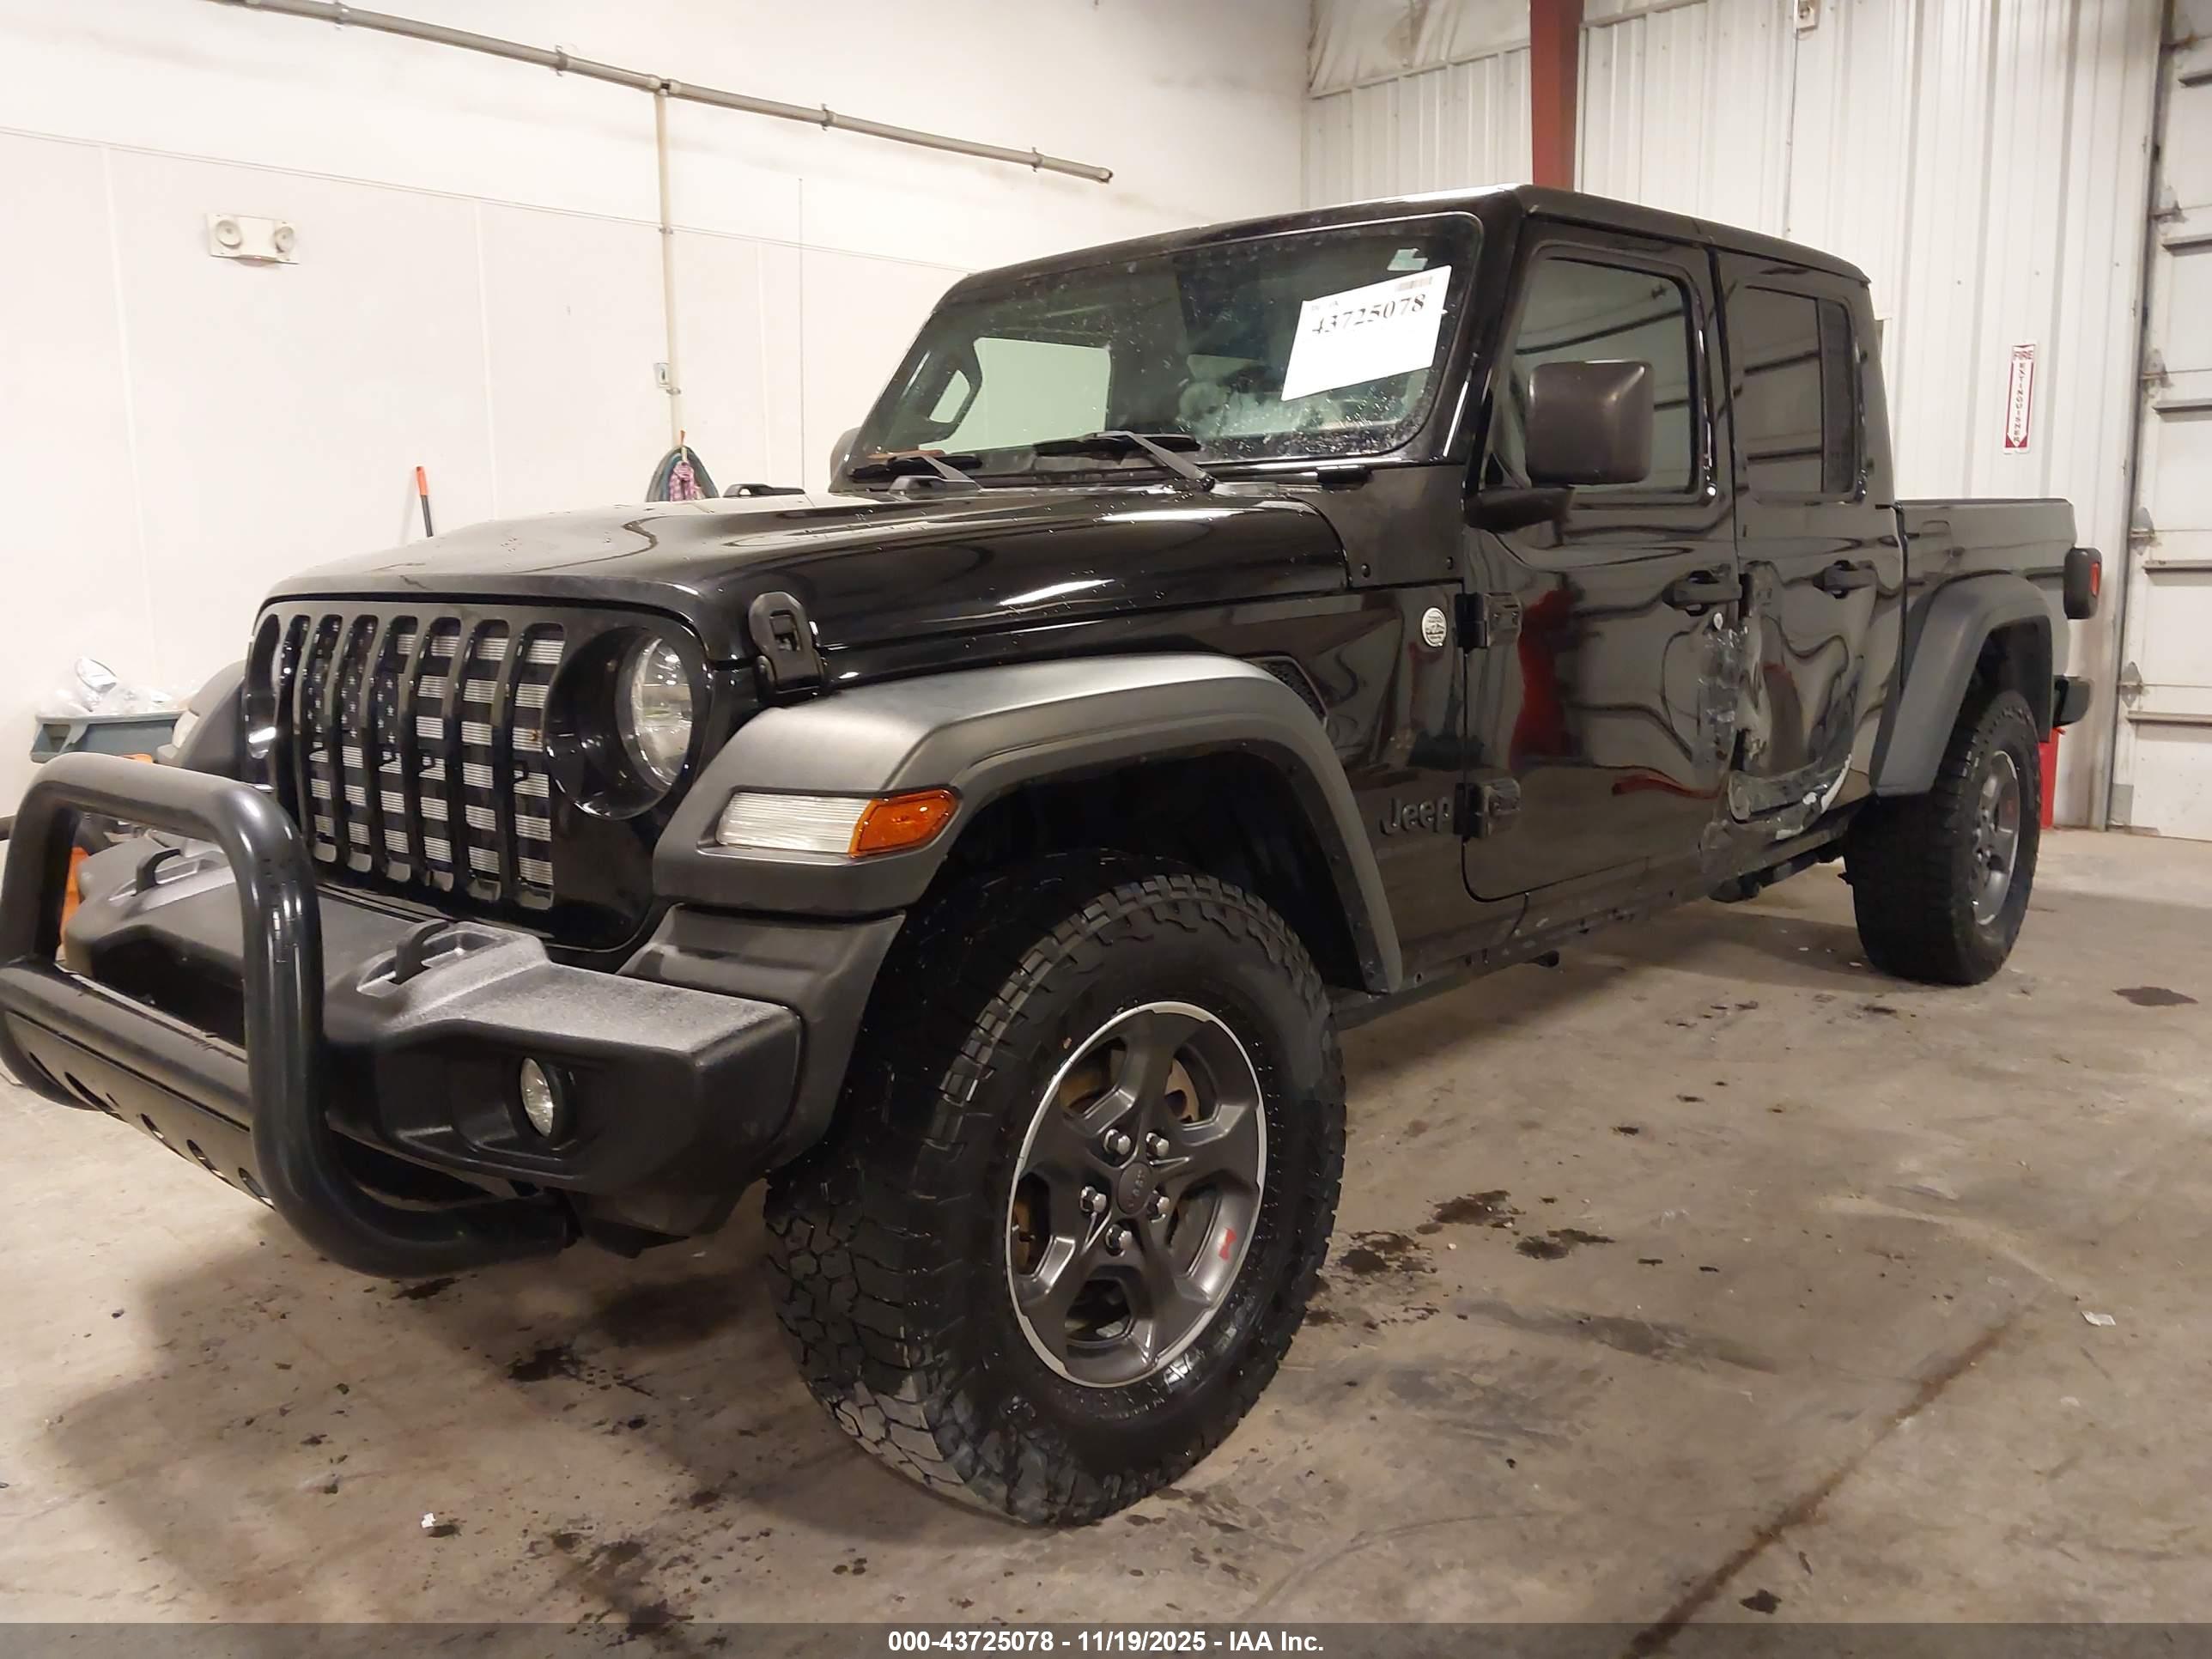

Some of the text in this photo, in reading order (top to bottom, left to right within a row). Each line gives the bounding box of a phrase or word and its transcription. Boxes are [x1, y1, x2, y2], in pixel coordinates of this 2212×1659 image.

[1311, 293, 1426, 335] 43725078
[2014, 362, 2026, 443] EXTINGUISHER
[1379, 796, 1451, 836] Jeep
